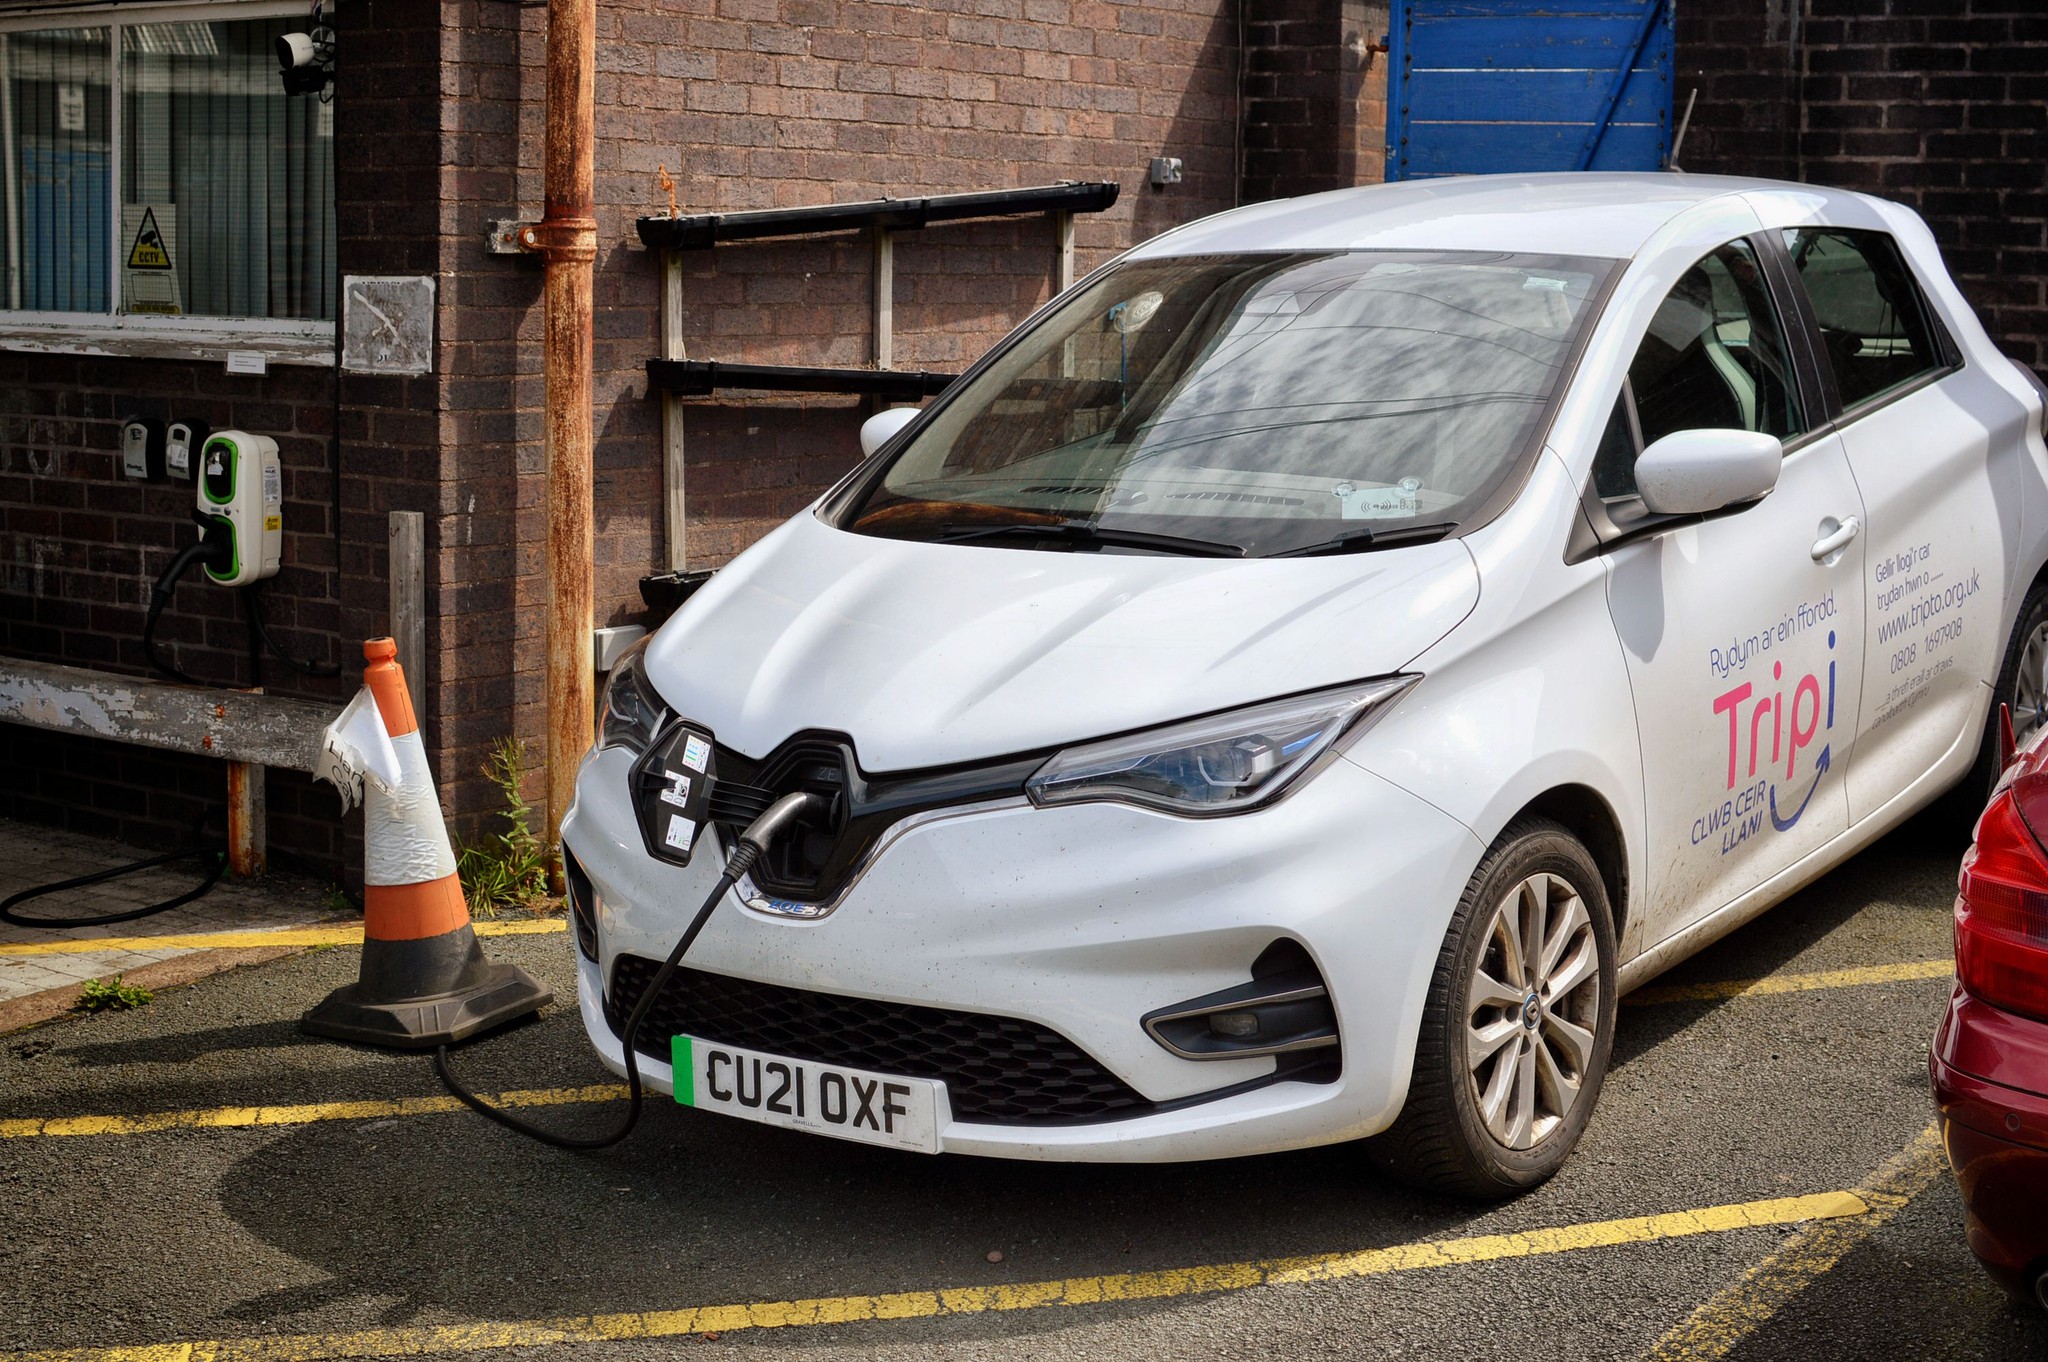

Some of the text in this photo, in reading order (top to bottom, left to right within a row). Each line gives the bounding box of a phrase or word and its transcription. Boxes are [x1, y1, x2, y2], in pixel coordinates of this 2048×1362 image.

[138, 252, 160, 263] CCTV
[1875, 558, 1896, 583] Gellir
[1918, 543, 1931, 561] car
[1877, 584, 1905, 612] trydan
[1905, 575, 1923, 596] hwn
[1923, 571, 1930, 585] o
[1878, 567, 1980, 646] www.tripto.org.uk
[1710, 589, 1838, 679] Rydym ar ein ffordd.
[1890, 617, 1963, 674] 0808 1697908
[1691, 780, 1766, 846] CLWB CEIR
[1722, 809, 1763, 856] LLANI
[768, 899, 805, 913] ZOE
[707, 1050, 911, 1134] CU21 OXF
